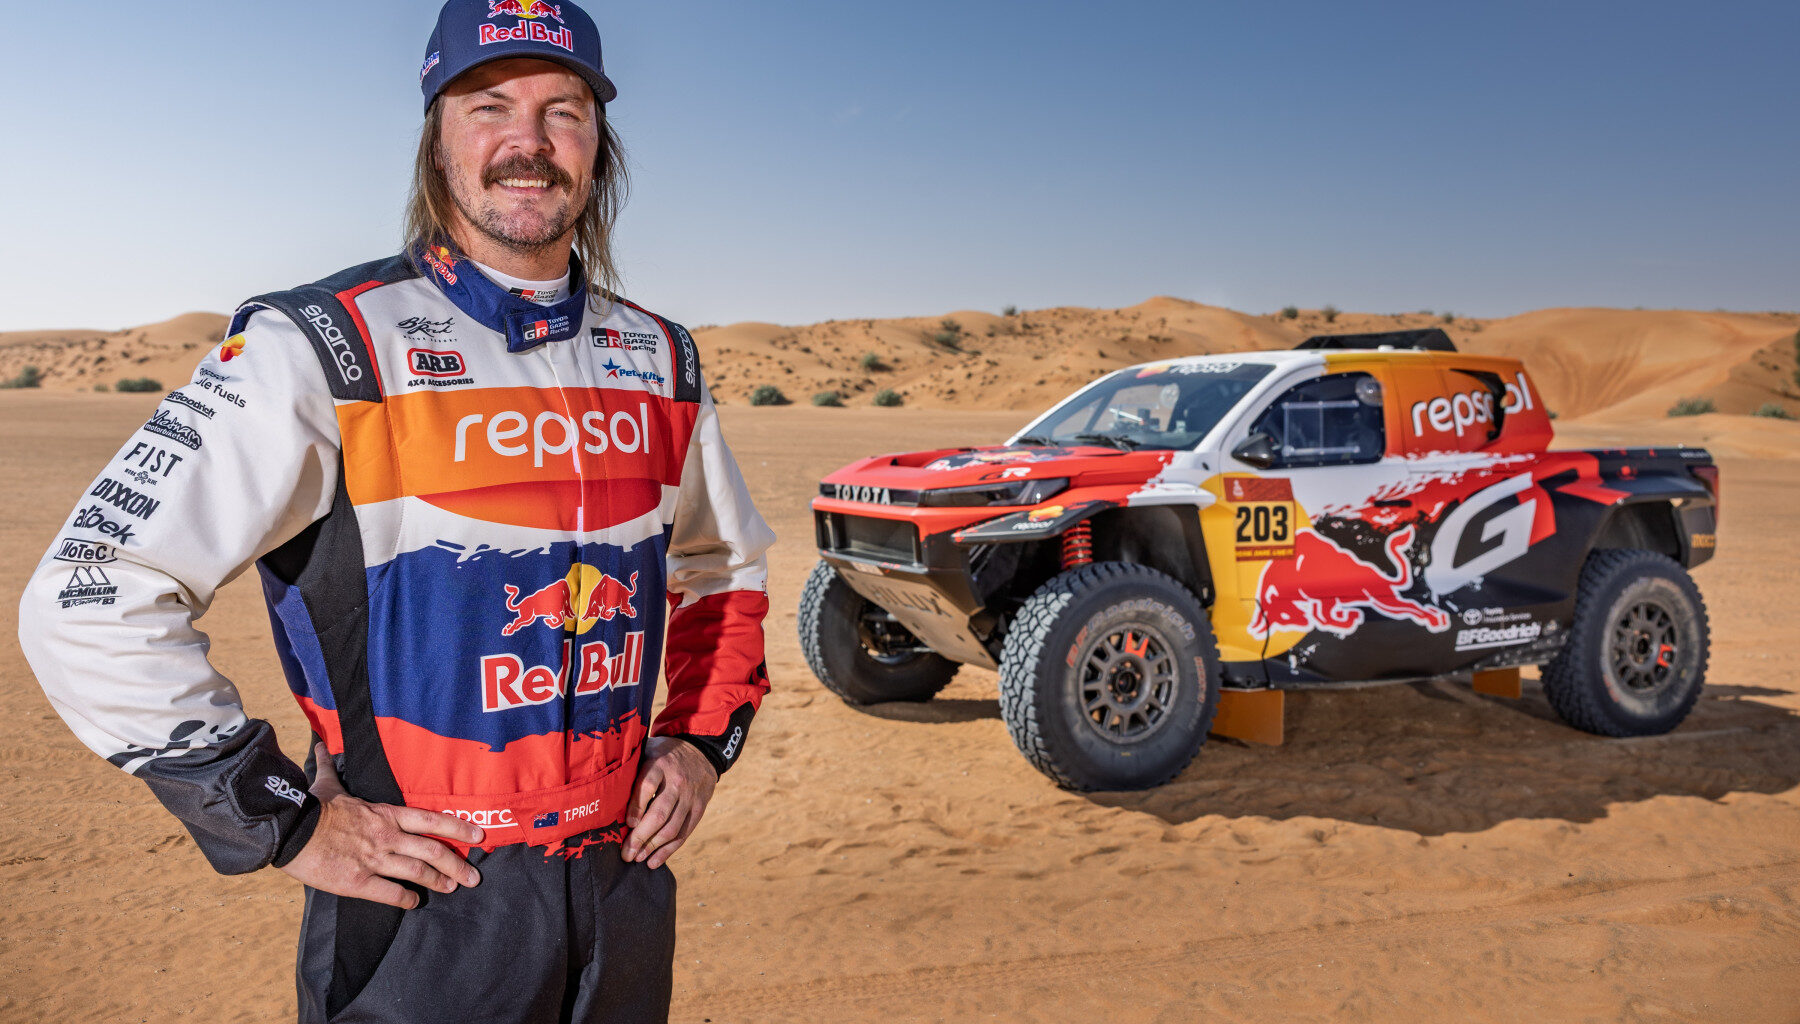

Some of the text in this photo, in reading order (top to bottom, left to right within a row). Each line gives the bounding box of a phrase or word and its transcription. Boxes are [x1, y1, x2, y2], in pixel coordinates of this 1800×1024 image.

[479, 20, 574, 52] Red Bull
[437, 260, 458, 285] Bull
[547, 315, 569, 324] TOYOTA
[303, 304, 362, 383] sparco
[525, 326, 548, 340] GR
[593, 335, 622, 348] GR
[621, 331, 659, 340] TOYOTA
[623, 338, 657, 346] GAZOO
[624, 344, 657, 354] Racing
[674, 325, 695, 388] sparco
[416, 352, 460, 373] ARB
[407, 379, 426, 387] 4X4
[212, 384, 247, 408] fuels
[1411, 372, 1534, 437] repsol
[454, 402, 650, 468] repsol
[123, 441, 184, 478] FIST
[90, 477, 161, 520] DIXXON
[834, 484, 891, 505] TOYOTA
[1236, 506, 1288, 542] 203
[1456, 621, 1541, 646] BFGoodrich
[480, 630, 645, 713] Red Bull
[722, 726, 743, 760] arco
[266, 775, 307, 807] spar
[564, 799, 601, 823] T.PRICE
